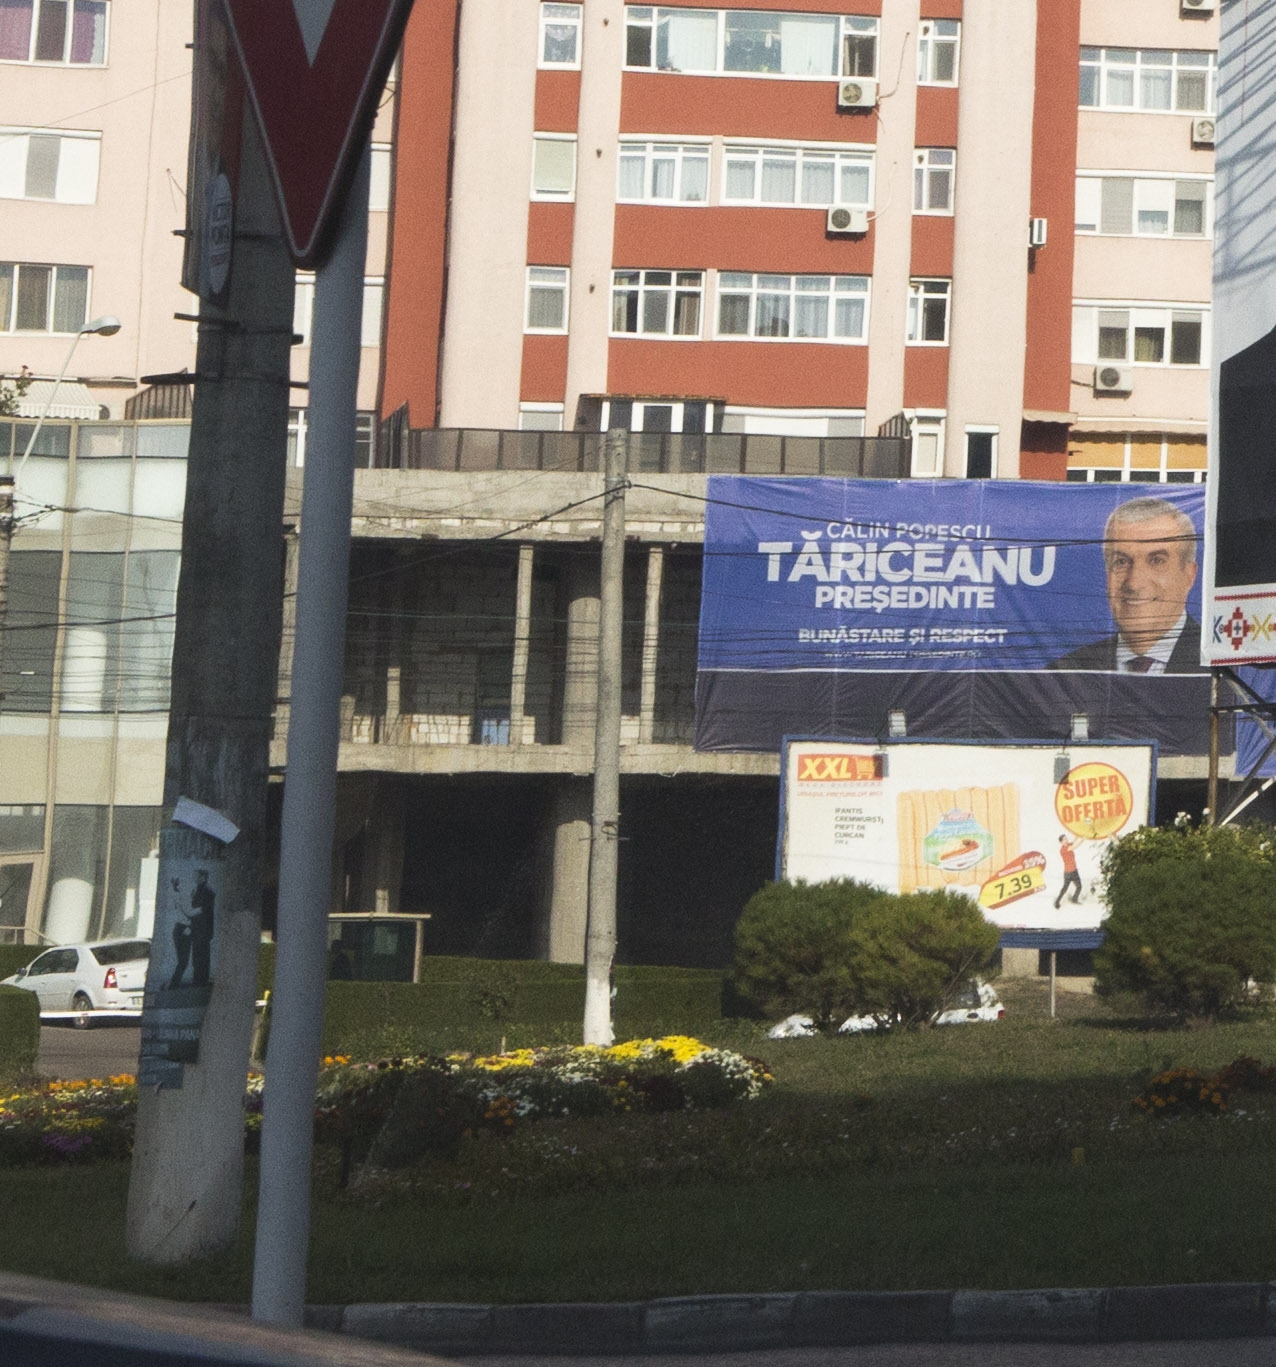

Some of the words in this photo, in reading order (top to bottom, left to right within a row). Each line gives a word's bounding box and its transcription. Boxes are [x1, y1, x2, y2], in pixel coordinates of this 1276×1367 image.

[827, 518, 889, 540] CĂLIN
[896, 523, 991, 541] POPESCU
[758, 531, 1056, 586] TĂRICEANU
[815, 585, 995, 613] PREȘEDINTE
[798, 627, 904, 643] BUNĂSTARE
[930, 629, 1008, 644] RESPECT
[799, 757, 852, 779] XXL
[1063, 775, 1119, 800] SUPER
[1062, 793, 1127, 823] OFERTĂ
[994, 874, 1032, 899] 7.39
